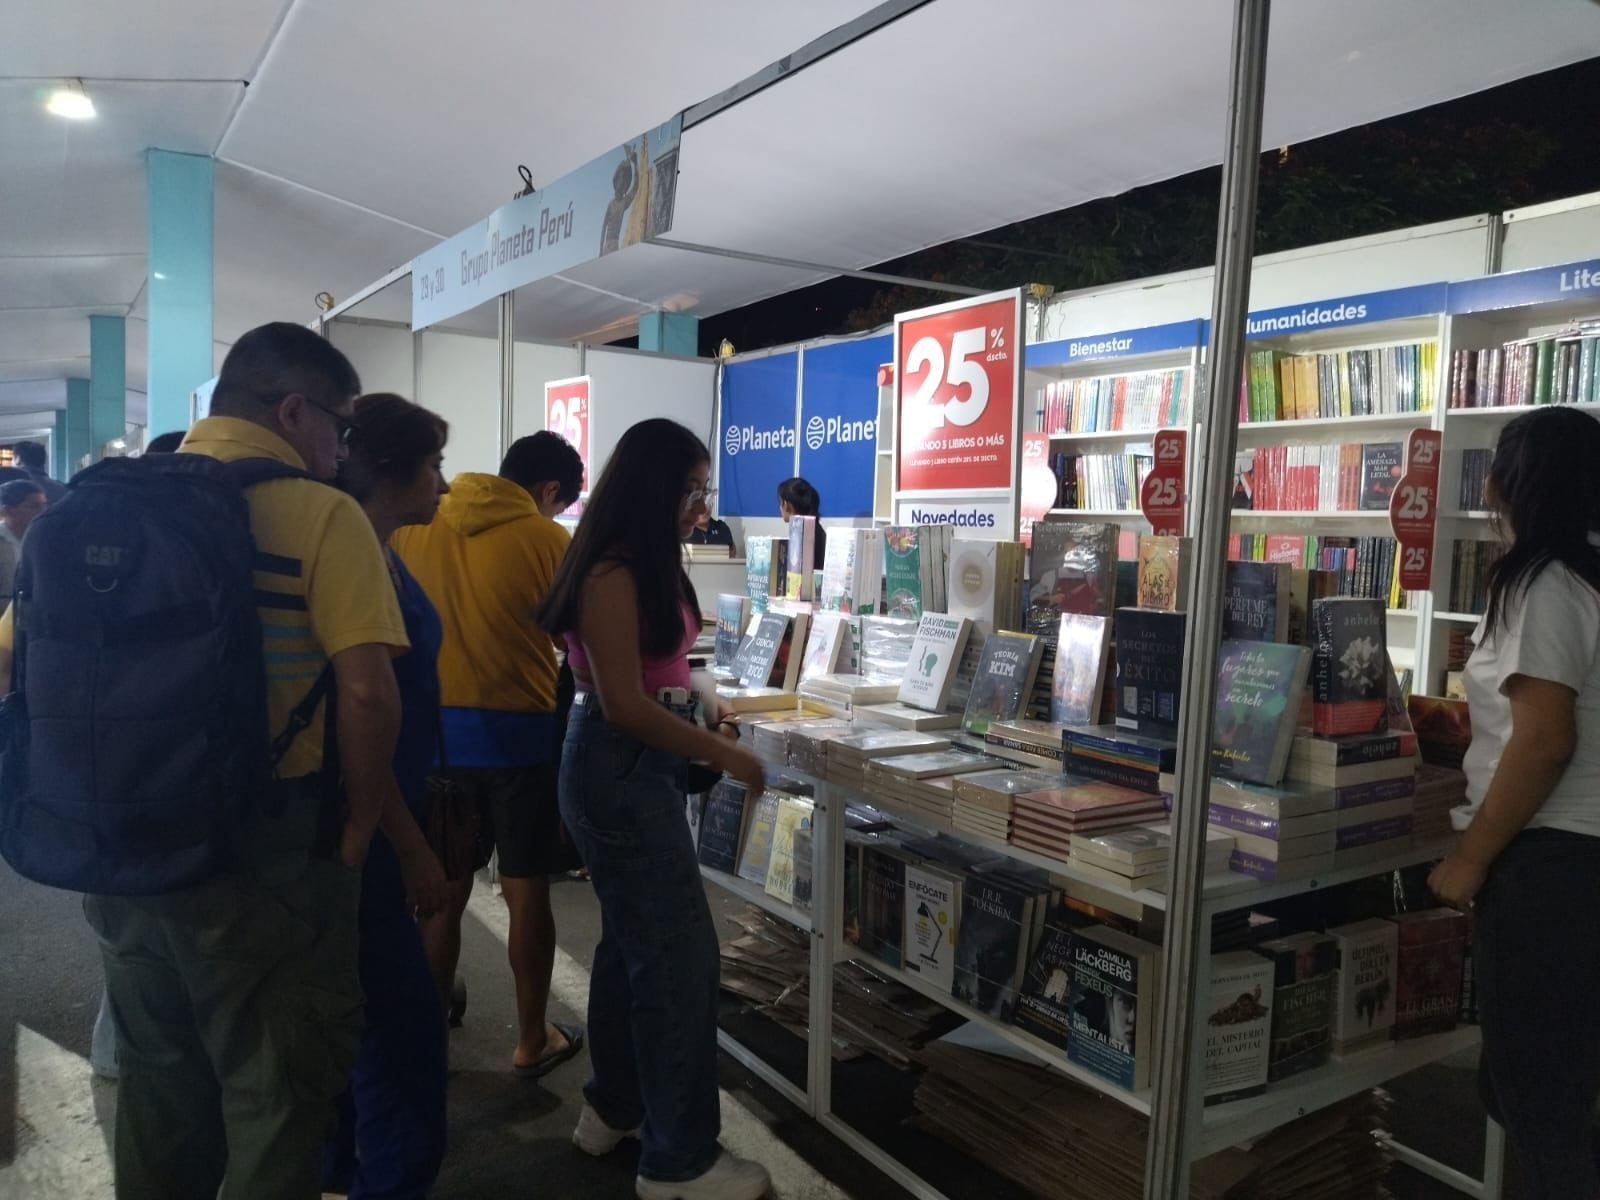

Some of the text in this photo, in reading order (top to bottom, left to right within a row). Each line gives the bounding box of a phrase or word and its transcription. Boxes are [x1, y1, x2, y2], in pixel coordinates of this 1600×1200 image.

[435, 267, 445, 293] 30
[460, 248, 490, 290] Grupo
[490, 226, 534, 272] Planeta
[538, 201, 574, 250] Perú
[1247, 302, 1367, 335] umanidades
[1069, 336, 1134, 358] Bienestar
[906, 326, 990, 429] 25
[742, 425, 796, 451] Planeta
[948, 437, 976, 449] LIBROS
[986, 432, 1005, 447] MÁS
[1025, 440, 1042, 457] 25
[1158, 438, 1179, 459] 25
[1412, 439, 1433, 463] 25
[1148, 477, 1177, 506] 25
[1398, 486, 1429, 520] 25
[911, 509, 995, 528] Novedades
[85, 545, 124, 567] CAT
[1404, 547, 1425, 571] 25
[1142, 574, 1163, 586] ALAS
[1224, 596, 1267, 615] PERFUME
[919, 626, 957, 640] FISCHMAN
[922, 617, 944, 628] DAVID
[988, 660, 1016, 677] KIM
[908, 879, 948, 902] ENFÓCATE
[971, 897, 1012, 921] TOLKIEN
[1075, 947, 1132, 982] LÄCKBERG
[1098, 948, 1132, 969] CAMILLA
[1074, 970, 1113, 998] FEXEUS
[1073, 1020, 1131, 1056] MENTALISTA
[1207, 1028, 1265, 1047] EL MISTERIO
[1205, 1040, 1261, 1059] DEL CAPITAL
